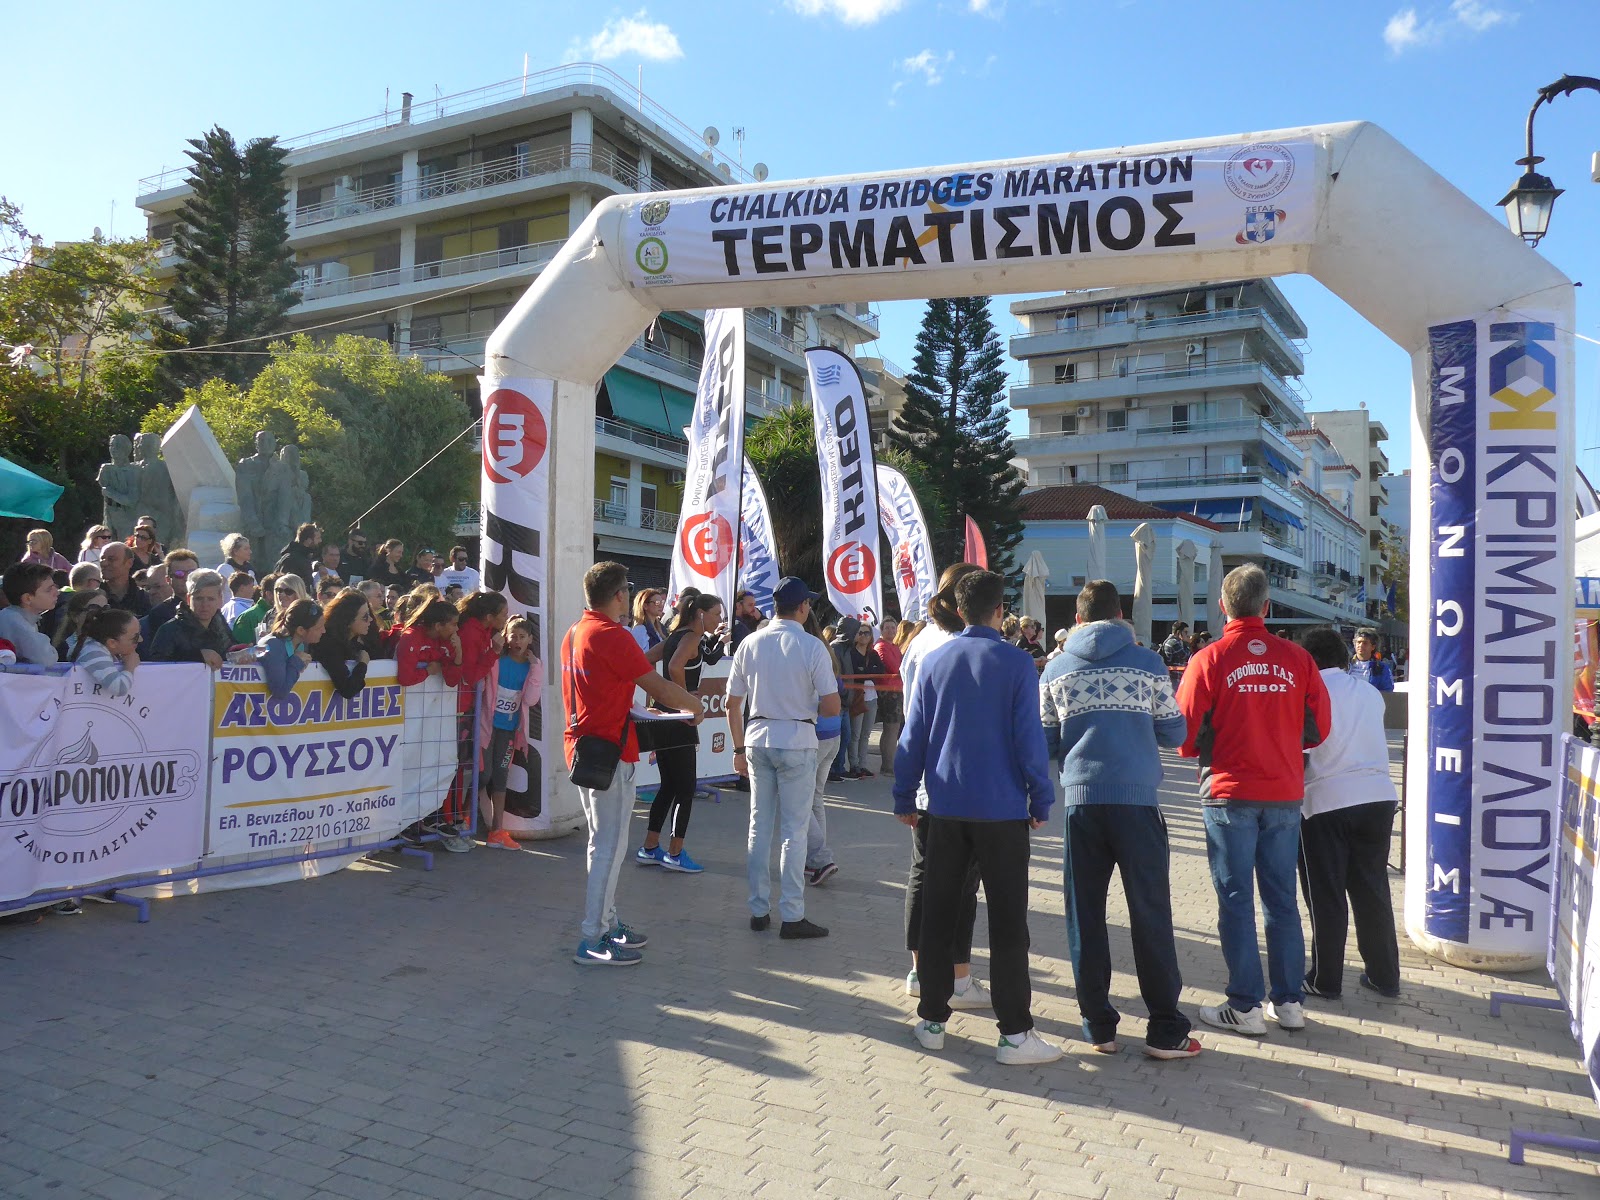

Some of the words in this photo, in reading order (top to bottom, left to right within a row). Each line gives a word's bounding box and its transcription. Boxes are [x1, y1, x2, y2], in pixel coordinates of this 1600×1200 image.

[710, 192, 851, 224] CHALKIDA
[860, 171, 993, 212] BRIDGES
[1002, 155, 1194, 199] MARATHON
[1245, 204, 1275, 213] ΣΕΓΑΣ
[711, 190, 1197, 277] ΤΕΡΜΑΤΙΣΜΟΣ
[220, 667, 262, 682] ΕΛΠΑ
[1226, 661, 1270, 689] ΕΥΒΟΪΚΟΣ
[1273, 664, 1296, 688] Γ.Α.Σ.
[1480, 444, 1558, 893] ΚΡΙΜΑΤΟΓΛΟΥ
[496, 700, 517, 711] 259
[1238, 684, 1287, 693] ΣΤΙΒΟΣ
[220, 685, 403, 727] ΑΣΦΑΛΕΙΕΣ
[222, 734, 399, 784] ΡΟΥΣΣΟΥ
[219, 814, 241, 831] Ελ.
[246, 808, 315, 827] Βενιζέλου
[319, 804, 334, 818] 70
[346, 794, 396, 813] Χαλκίδα
[249, 829, 287, 848] Τηλ.:
[290, 823, 330, 843] 22210
[333, 816, 371, 836] 61282
